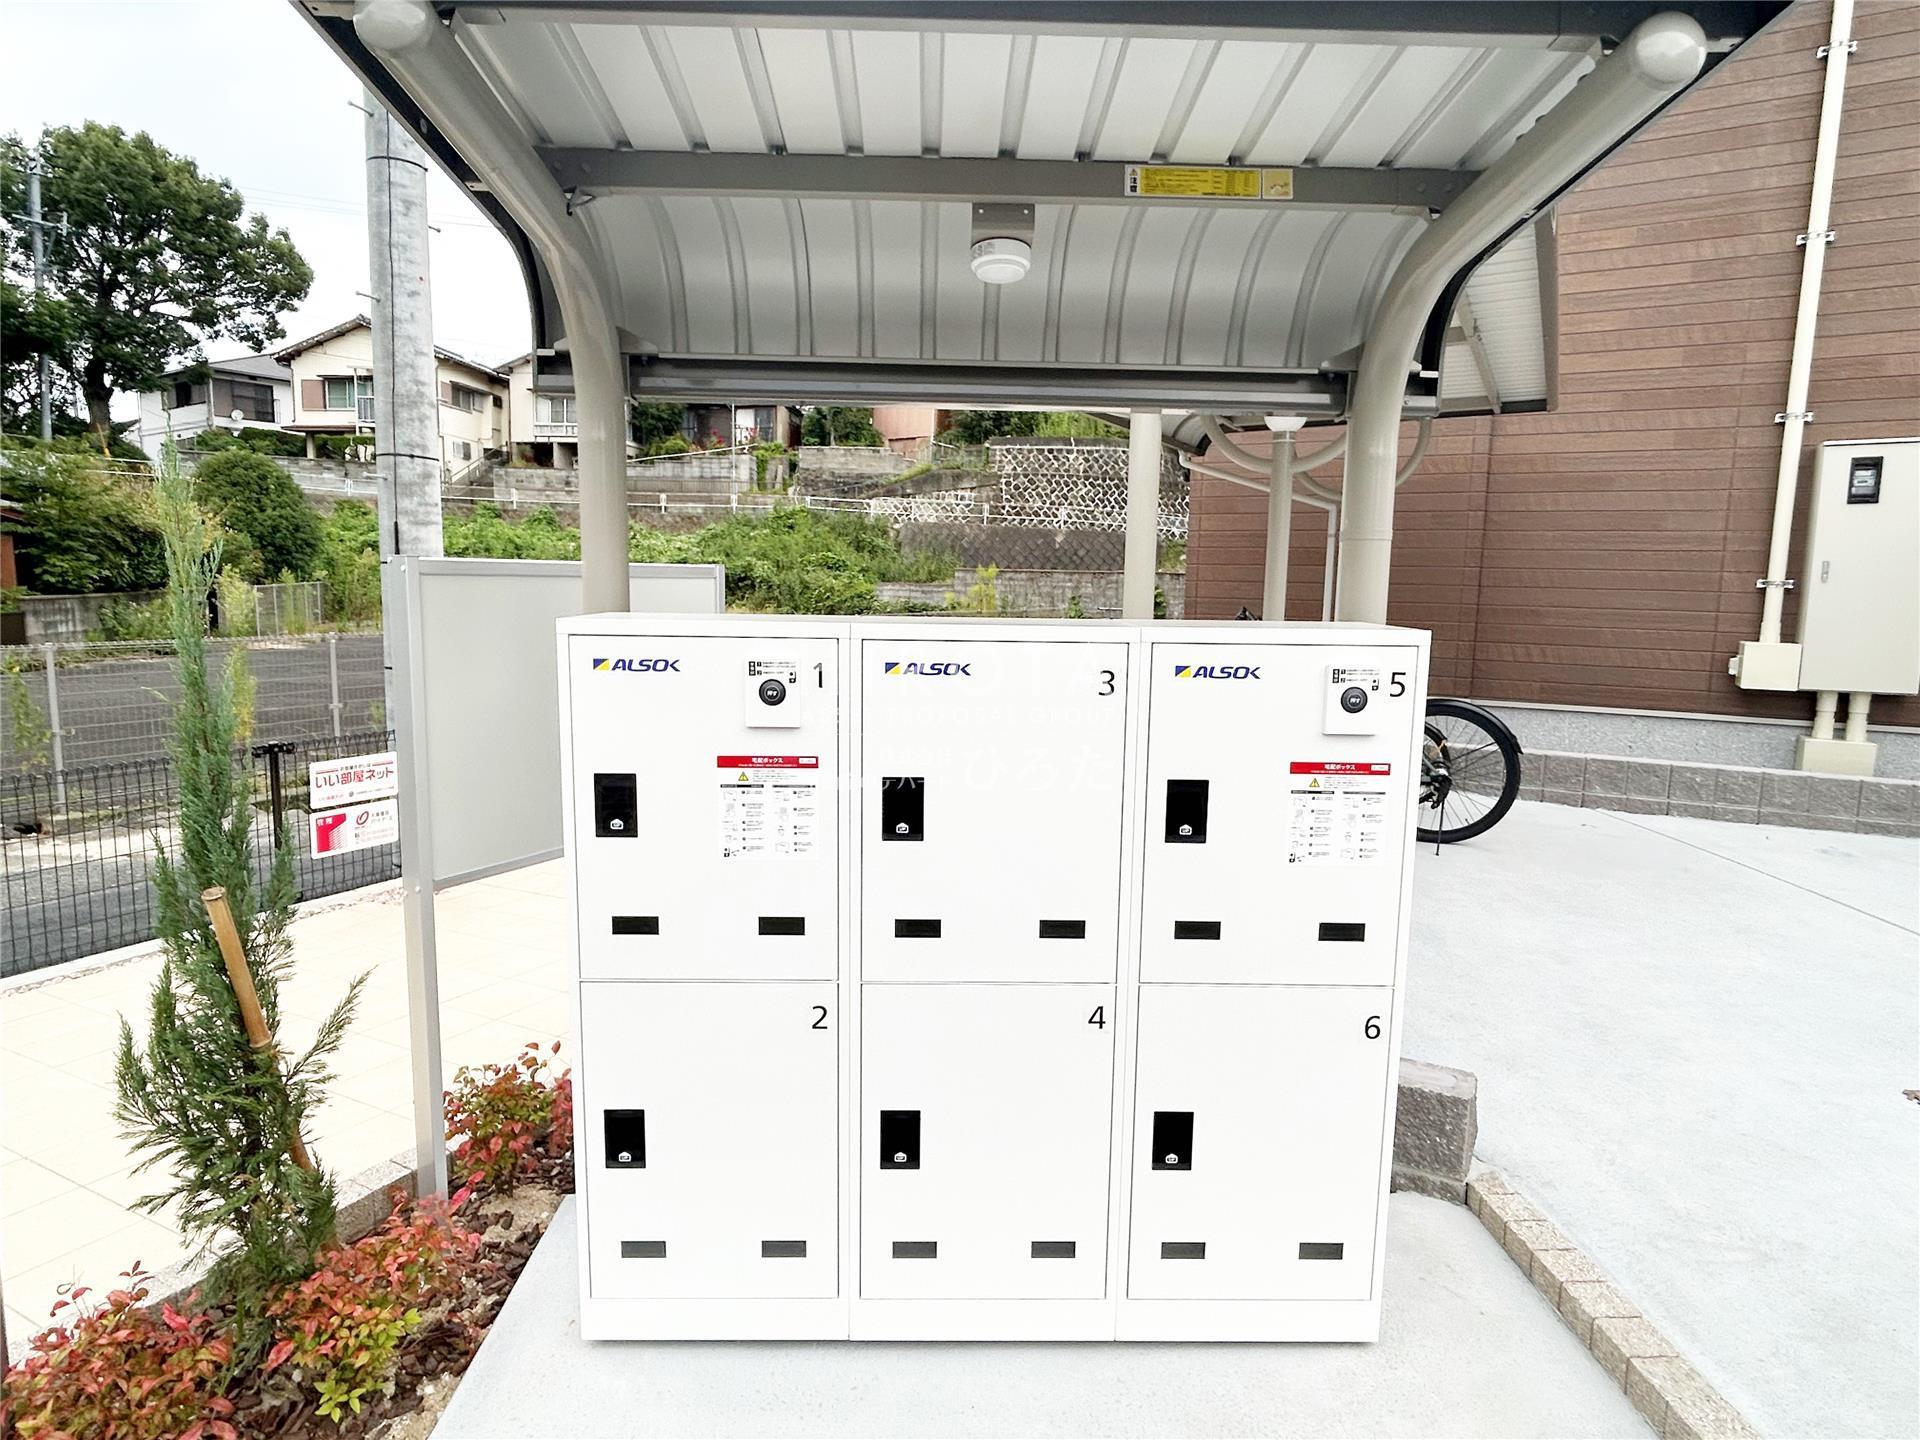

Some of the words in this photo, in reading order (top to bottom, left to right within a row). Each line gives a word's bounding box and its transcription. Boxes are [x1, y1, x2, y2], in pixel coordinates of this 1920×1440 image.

[611, 659, 680, 672] ALSOK
[813, 662, 823, 688] 1
[903, 662, 971, 676] ALSOK
[1193, 666, 1261, 679] ALSOK
[1098, 670, 1116, 696] 3
[1390, 672, 1406, 697] 5
[315, 767, 394, 788] いい部屋ネット
[811, 1006, 828, 1029] 2
[1088, 1006, 1106, 1029] 4
[1364, 1016, 1381, 1039] 6
